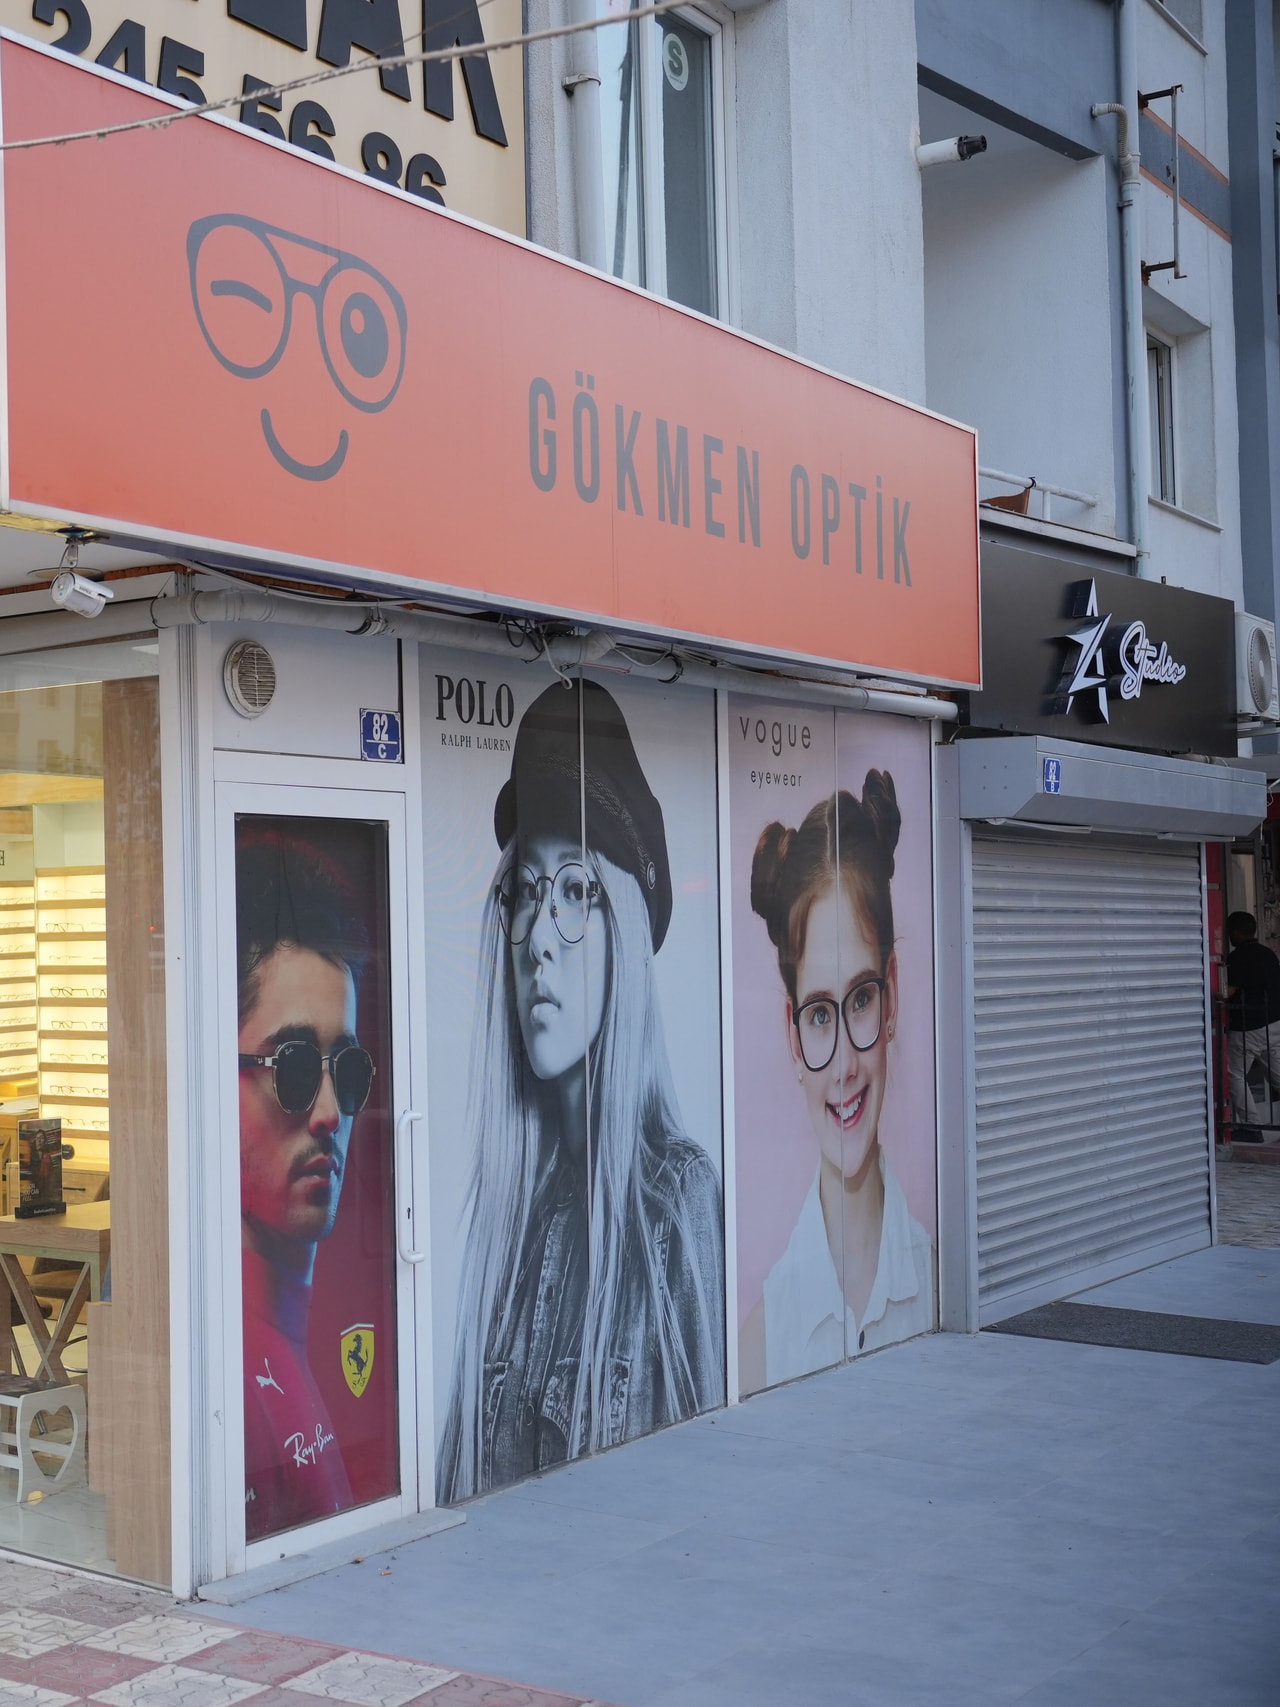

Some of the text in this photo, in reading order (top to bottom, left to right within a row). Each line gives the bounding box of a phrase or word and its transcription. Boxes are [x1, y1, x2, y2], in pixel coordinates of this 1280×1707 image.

[528, 370, 913, 588] GÖKMEN OPTİK
[1119, 620, 1187, 700] Studio
[434, 674, 515, 729] POLO
[372, 713, 389, 741] 82
[441, 733, 511, 752] RALPH LAUREN
[739, 716, 811, 757] vogue
[377, 743, 387, 759] C
[750, 770, 802, 790] eyewear
